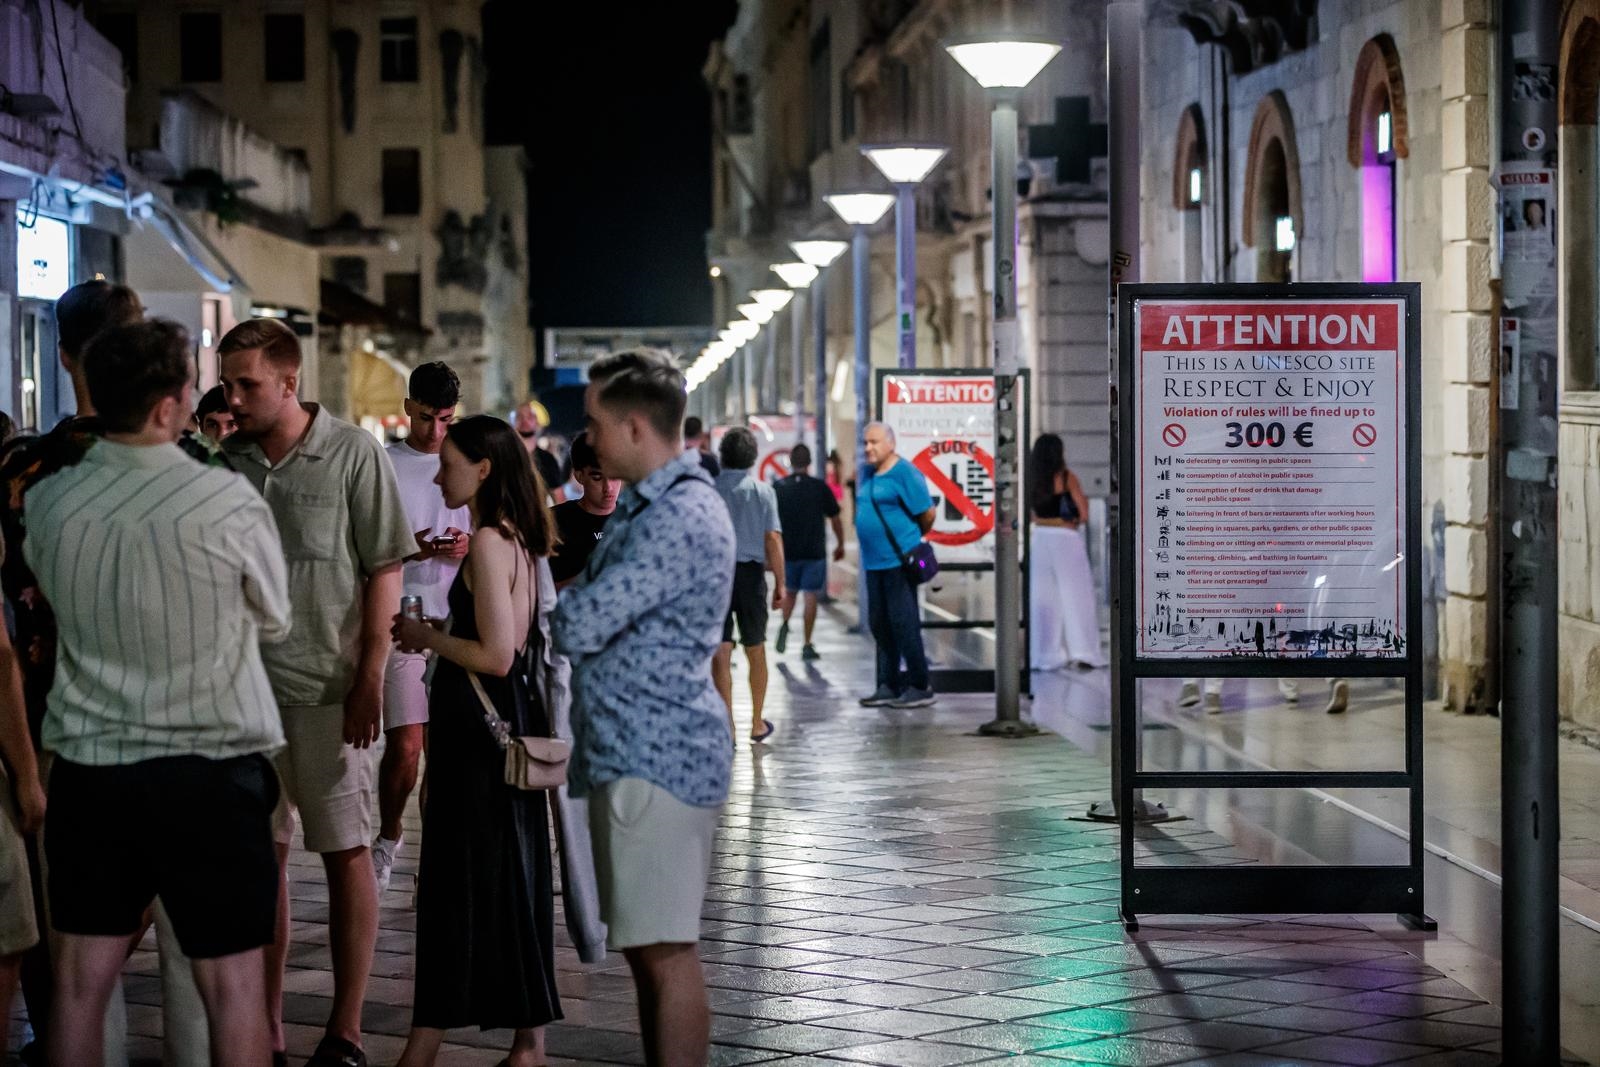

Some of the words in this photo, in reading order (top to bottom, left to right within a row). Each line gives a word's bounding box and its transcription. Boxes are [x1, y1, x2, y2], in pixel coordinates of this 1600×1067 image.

[1162, 314, 1375, 344] ATTENTION
[1164, 355, 1205, 370] THIS
[1214, 358, 1227, 370] IS
[1235, 358, 1244, 370] A
[1252, 355, 1332, 370] UNESCO
[1340, 357, 1375, 370] SITE
[898, 384, 994, 402] ATTENTIO
[1164, 378, 1266, 397] RESPECT
[1276, 378, 1292, 397] &
[1304, 378, 1374, 400] ENJOY
[1164, 407, 1217, 416] Violation
[1221, 407, 1233, 416] of
[1236, 406, 1265, 416] rules
[1268, 406, 1289, 416] will
[1292, 407, 1307, 416] be
[1310, 406, 1340, 416] fined
[1345, 409, 1359, 418] up
[1363, 408, 1375, 417] to
[1226, 422, 1285, 448] 300
[1293, 422, 1313, 447] €
